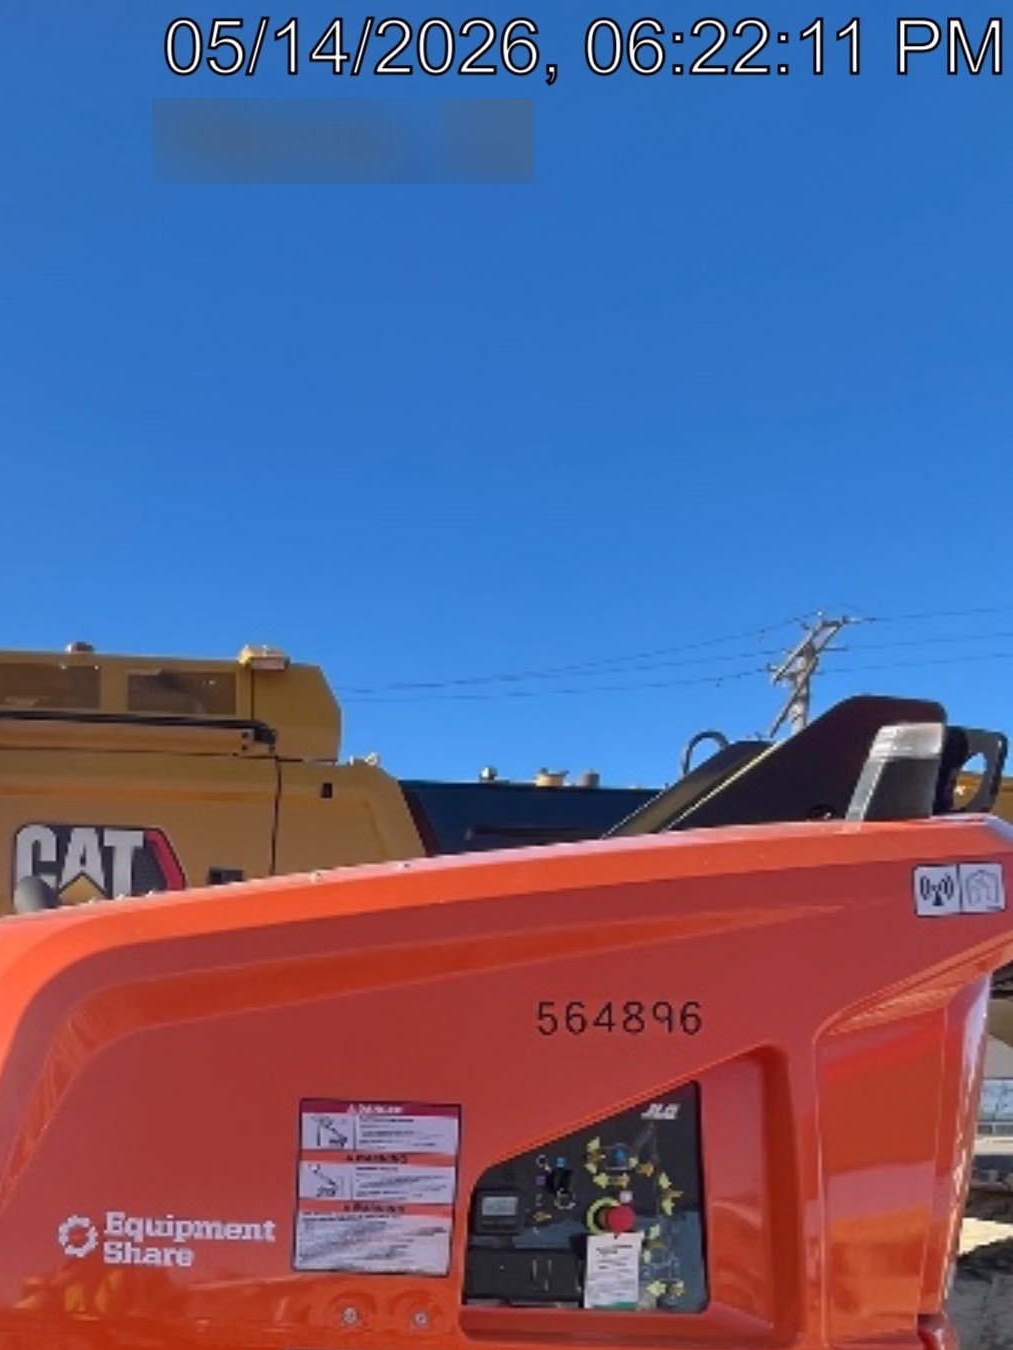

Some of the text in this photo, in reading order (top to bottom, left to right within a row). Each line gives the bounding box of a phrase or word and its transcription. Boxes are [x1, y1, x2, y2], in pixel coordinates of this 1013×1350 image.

[15, 822, 145, 899] CAT
[537, 1000, 703, 1035] 564896
[104, 1211, 276, 1242] Equipment
[103, 1241, 195, 1267] Share
